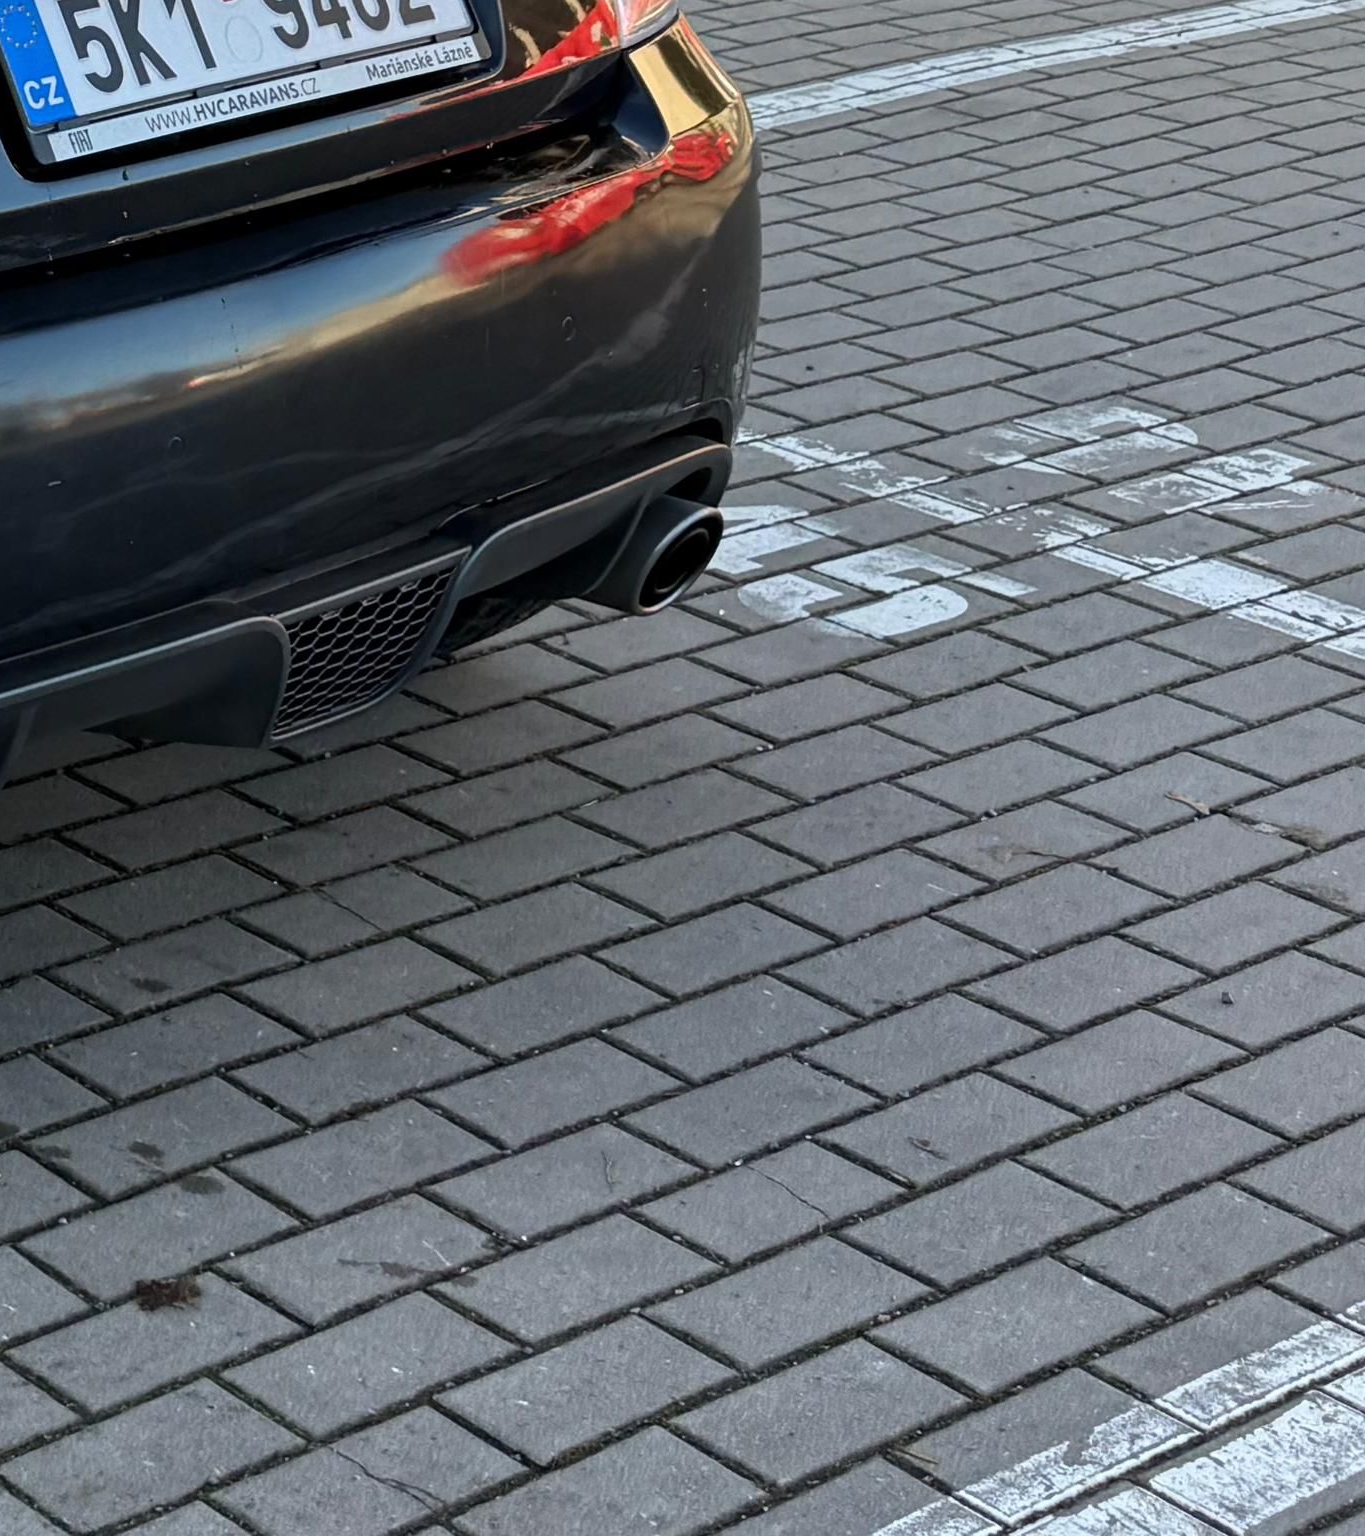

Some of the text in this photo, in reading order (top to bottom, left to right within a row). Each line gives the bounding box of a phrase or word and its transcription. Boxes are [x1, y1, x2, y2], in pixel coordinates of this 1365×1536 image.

[365, 42, 474, 81] Mariánské Lázně
[22, 75, 65, 110] CZ
[144, 77, 321, 133] WWW.HVCARAVANS.CZ
[68, 128, 94, 155] FIAT
